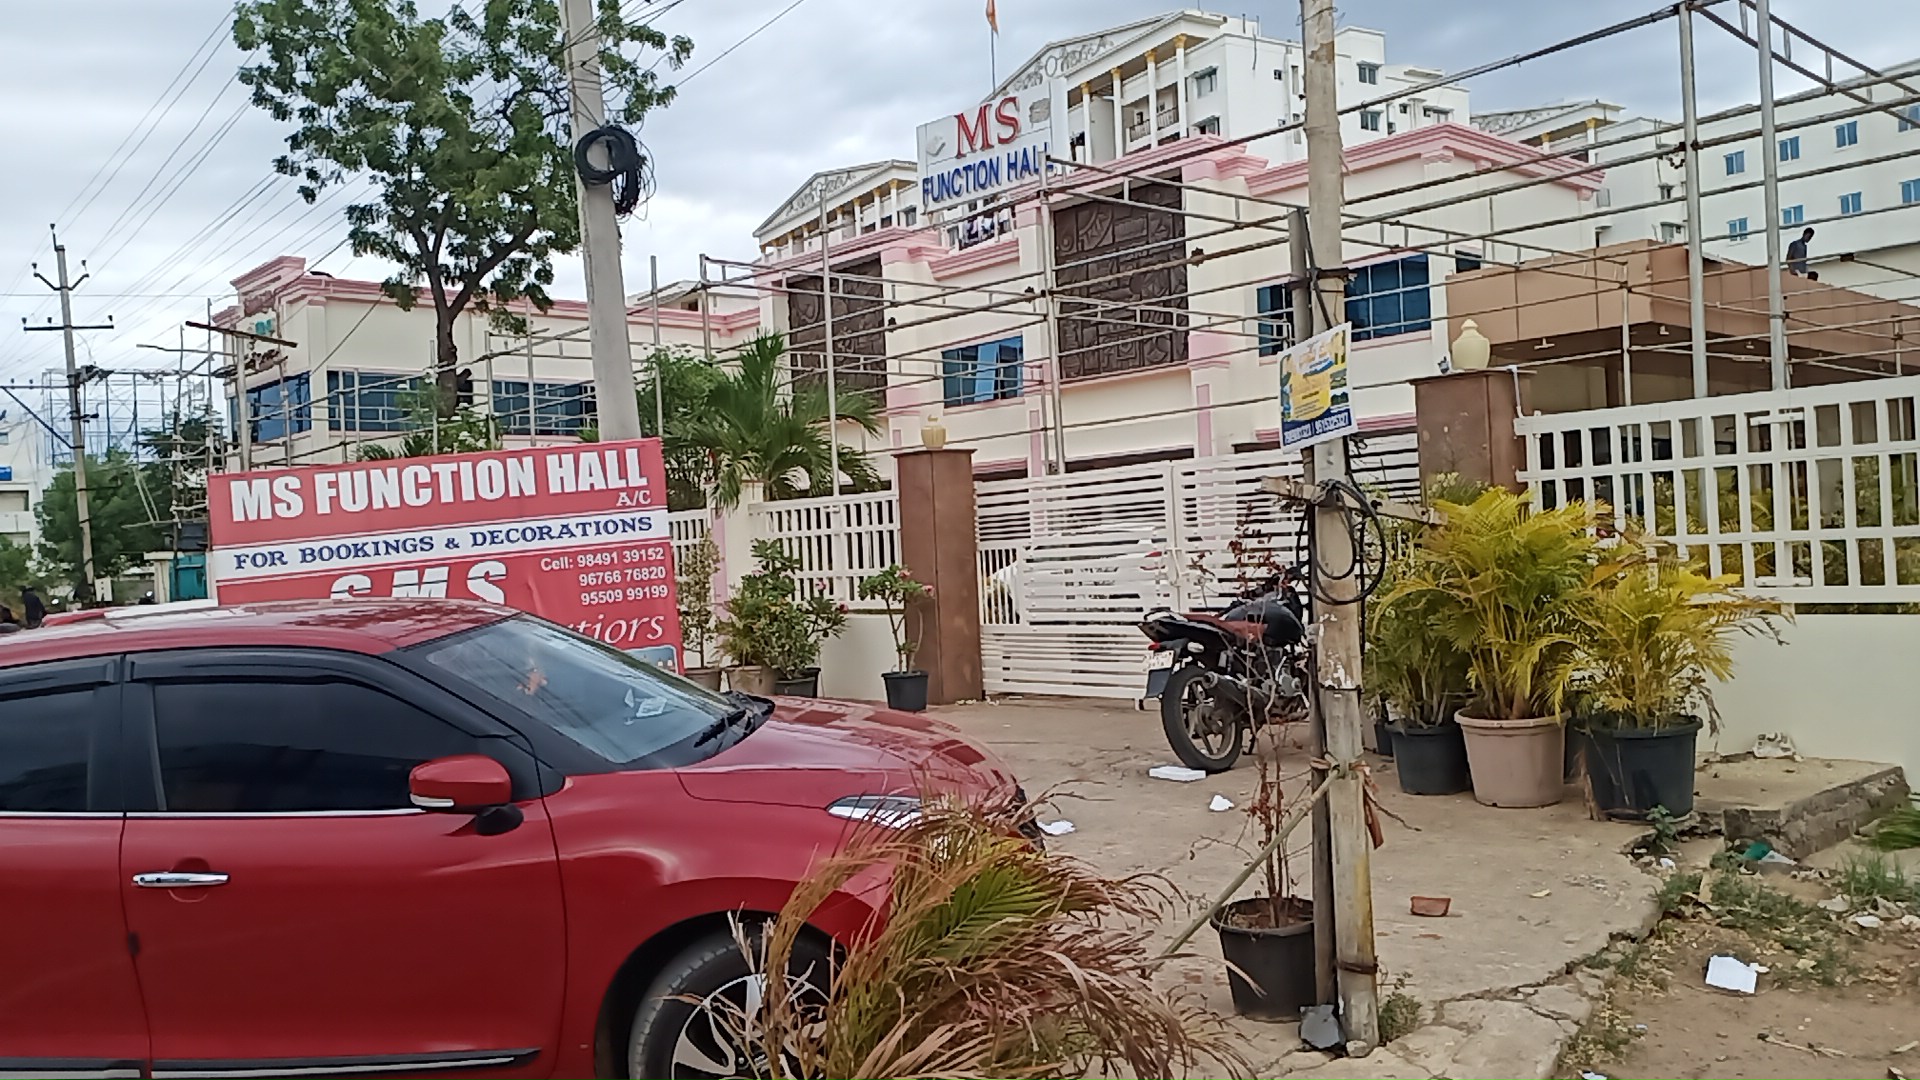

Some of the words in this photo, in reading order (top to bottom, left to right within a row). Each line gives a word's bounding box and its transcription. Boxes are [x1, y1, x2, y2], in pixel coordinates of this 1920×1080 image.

[954, 96, 1021, 159] MS
[922, 156, 1001, 206] FUNCTION
[1007, 142, 1054, 182] HALL
[230, 478, 304, 522] MS
[314, 456, 536, 515] FUNCTION
[546, 447, 648, 494] HALL
[616, 490, 652, 507] A/C
[234, 550, 289, 571] FOR
[300, 535, 434, 564] BOOKINGS
[445, 536, 461, 551] &
[470, 516, 653, 548] DECORATIONS
[540, 556, 574, 571] Cell:
[577, 551, 619, 567] 98491
[622, 547, 665, 563] 39152
[579, 570, 621, 586] 96766
[624, 566, 666, 581] 76820
[580, 589, 623, 606] 95509
[626, 584, 669, 600] 99199
